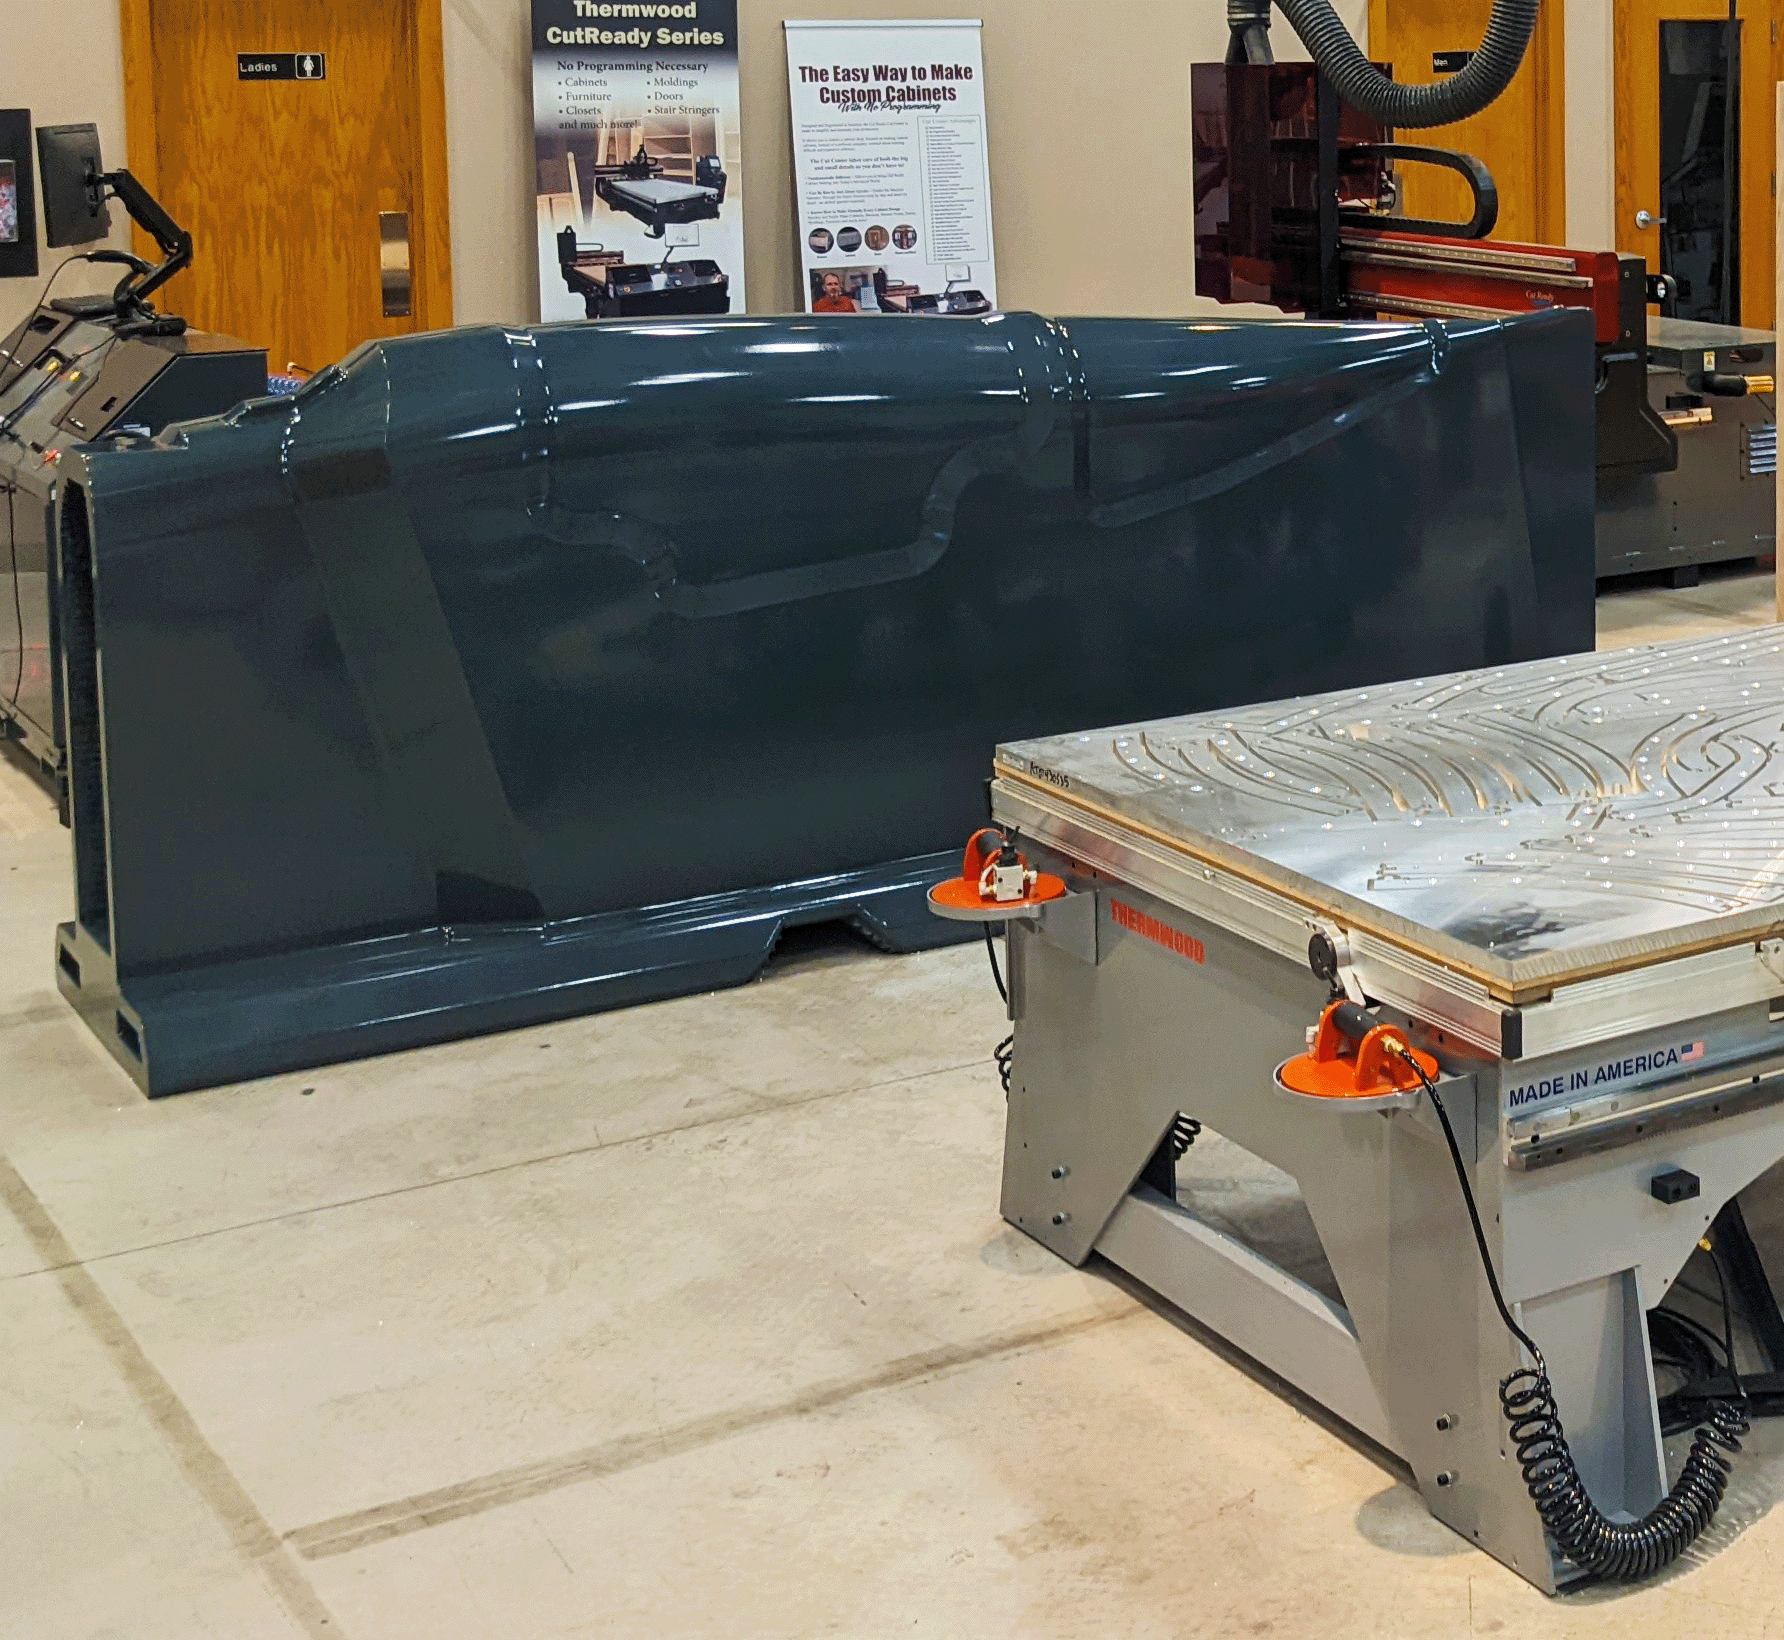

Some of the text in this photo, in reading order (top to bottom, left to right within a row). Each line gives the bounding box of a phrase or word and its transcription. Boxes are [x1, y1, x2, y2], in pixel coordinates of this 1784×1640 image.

[573, 0, 697, 18] Thermwood
[546, 26, 725, 48] CutReady Series
[240, 63, 278, 73] Ladies
[557, 61, 709, 74] No Programming Necessary
[799, 64, 973, 84] The Easy Way to Make
[565, 78, 608, 87] Cabinets
[654, 77, 698, 89] Moldings
[565, 92, 612, 101] Furniture
[654, 92, 684, 101] Doors
[819, 85, 957, 104] Custom Cabinets
[566, 106, 601, 115] Closets
[654, 106, 720, 118] Stair Stringers
[838, 100, 941, 114] With No Programming
[559, 120, 577, 129] and
[580, 120, 607, 129] much
[1108, 898, 1206, 966] THERMWOOD
[1509, 1047, 1679, 1107] MADE IN AMERICA
